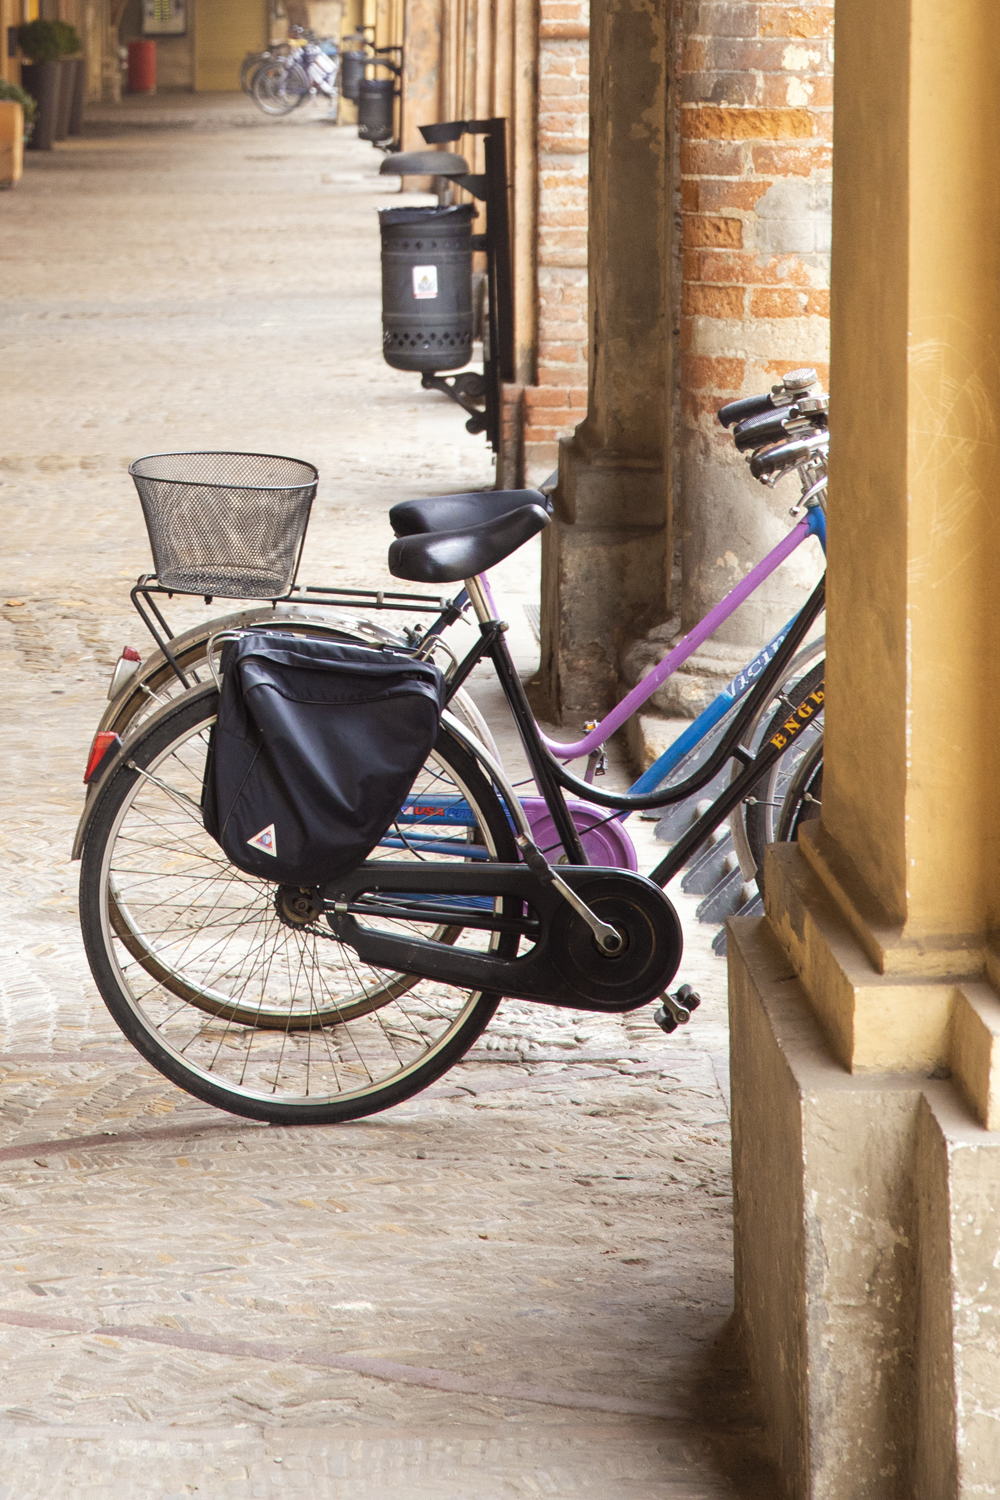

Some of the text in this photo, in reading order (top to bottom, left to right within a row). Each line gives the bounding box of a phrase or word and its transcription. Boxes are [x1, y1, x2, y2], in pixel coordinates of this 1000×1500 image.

[725, 621, 793, 698] Vicin
[769, 681, 826, 750] ENGL
[414, 806, 445, 817] USA
